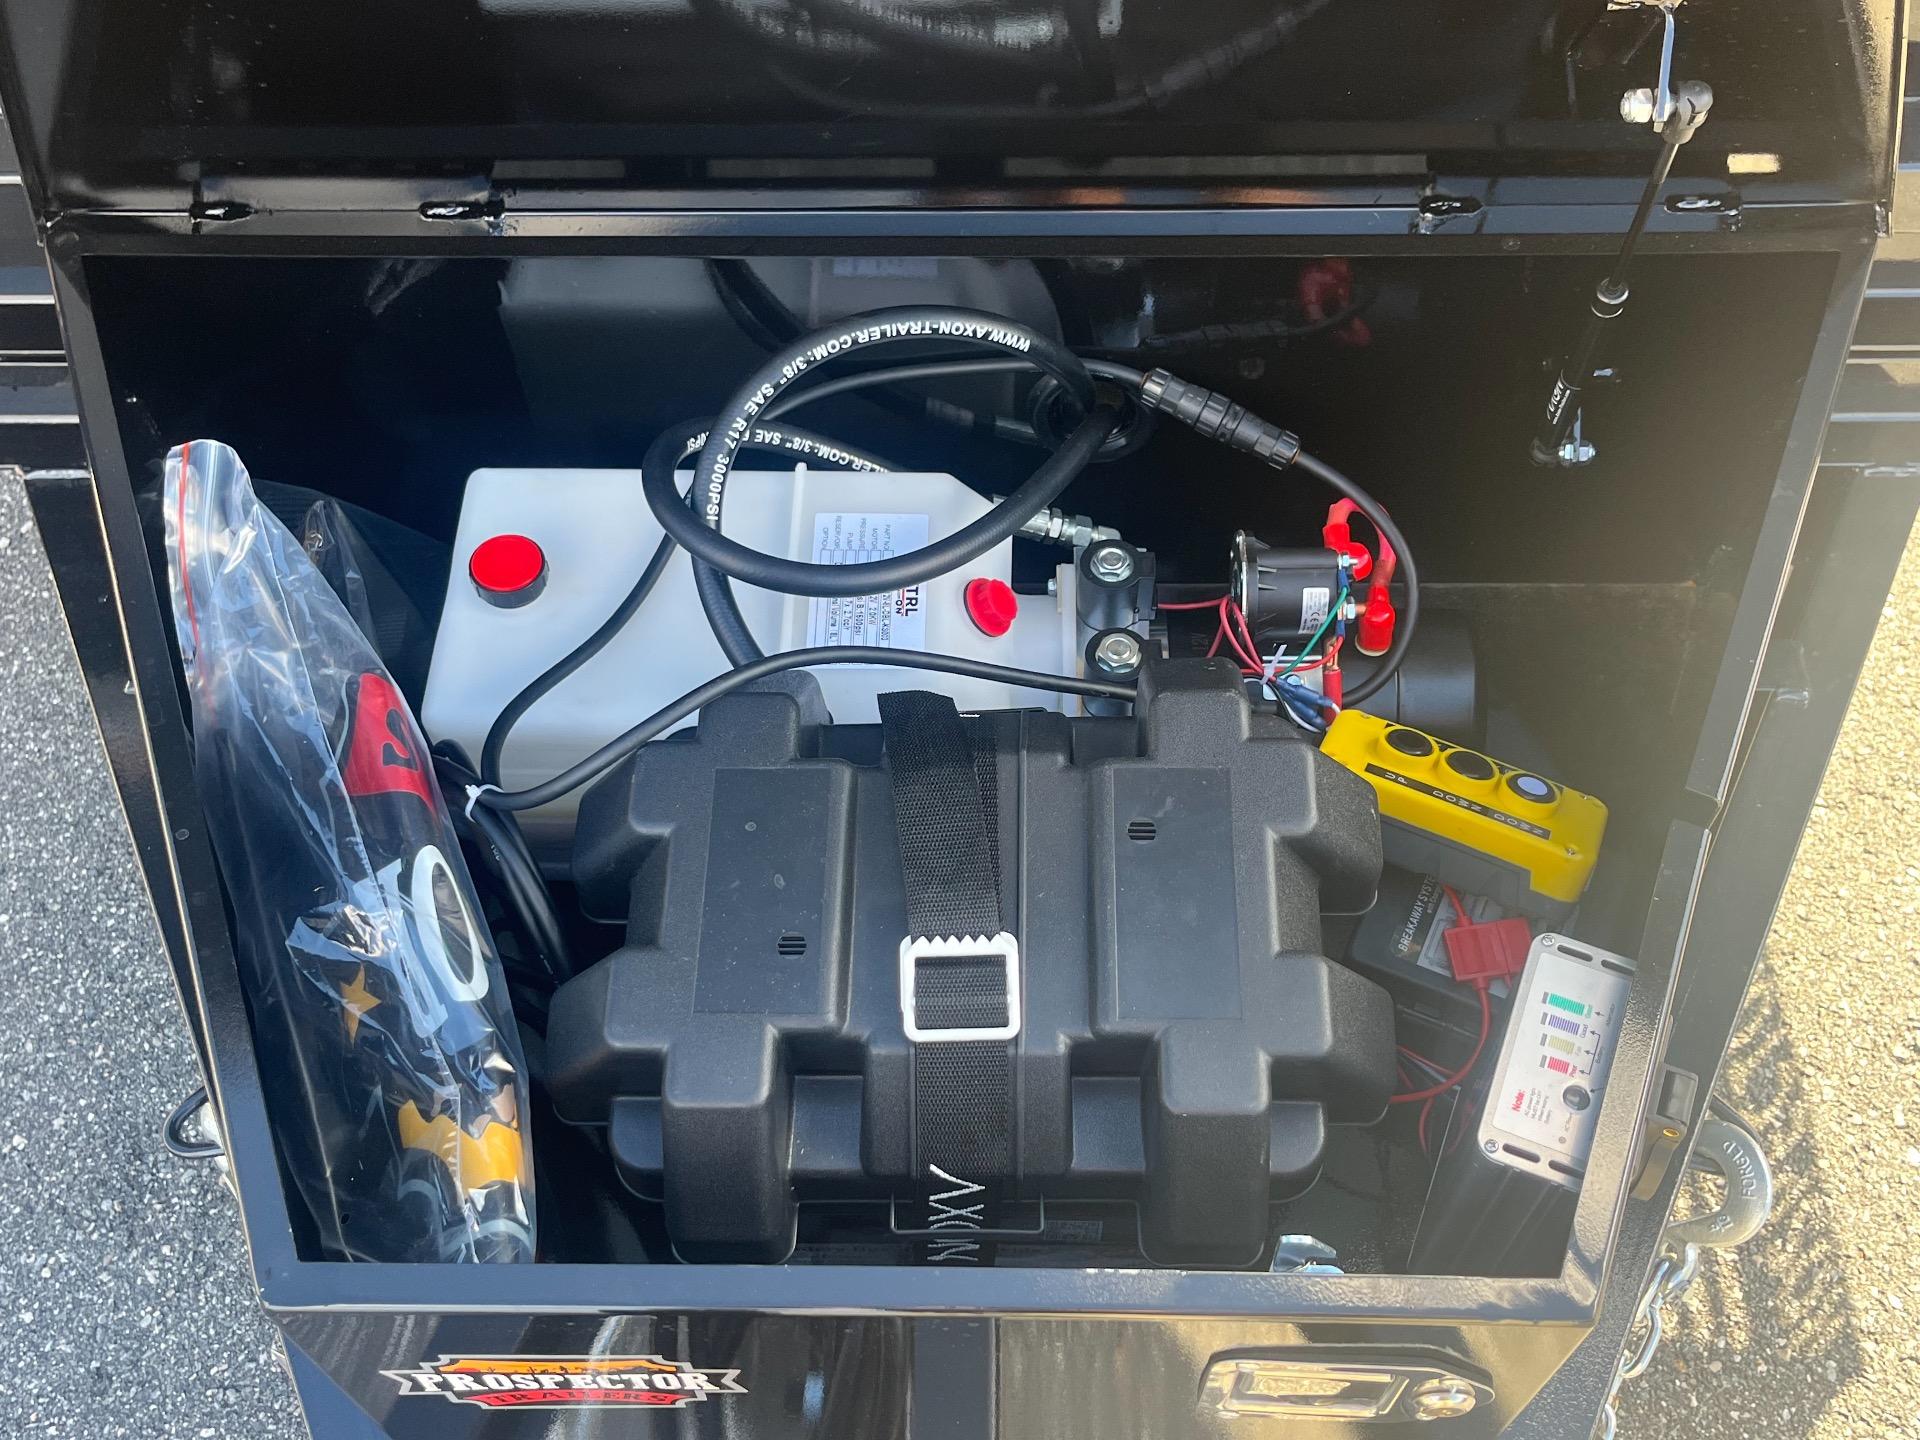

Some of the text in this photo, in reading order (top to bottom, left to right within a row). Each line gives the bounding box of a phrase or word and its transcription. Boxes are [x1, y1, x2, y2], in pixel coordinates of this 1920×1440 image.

[808, 320, 1031, 363] WWW.AXON-TRAILER.COM:
[779, 356, 808, 386] 3/8"
[744, 382, 774, 416] SAE
[724, 417, 749, 449] R17
[754, 429, 781, 445] SAE
[706, 453, 730, 520] 3000PSI
[904, 586, 919, 617] TRL
[1385, 772, 1409, 785] UP
[1398, 903, 1425, 952] BREAKAWAY
[412, 1373, 721, 1391] PROSPECTOR
[496, 1390, 669, 1404] TRAILERS
